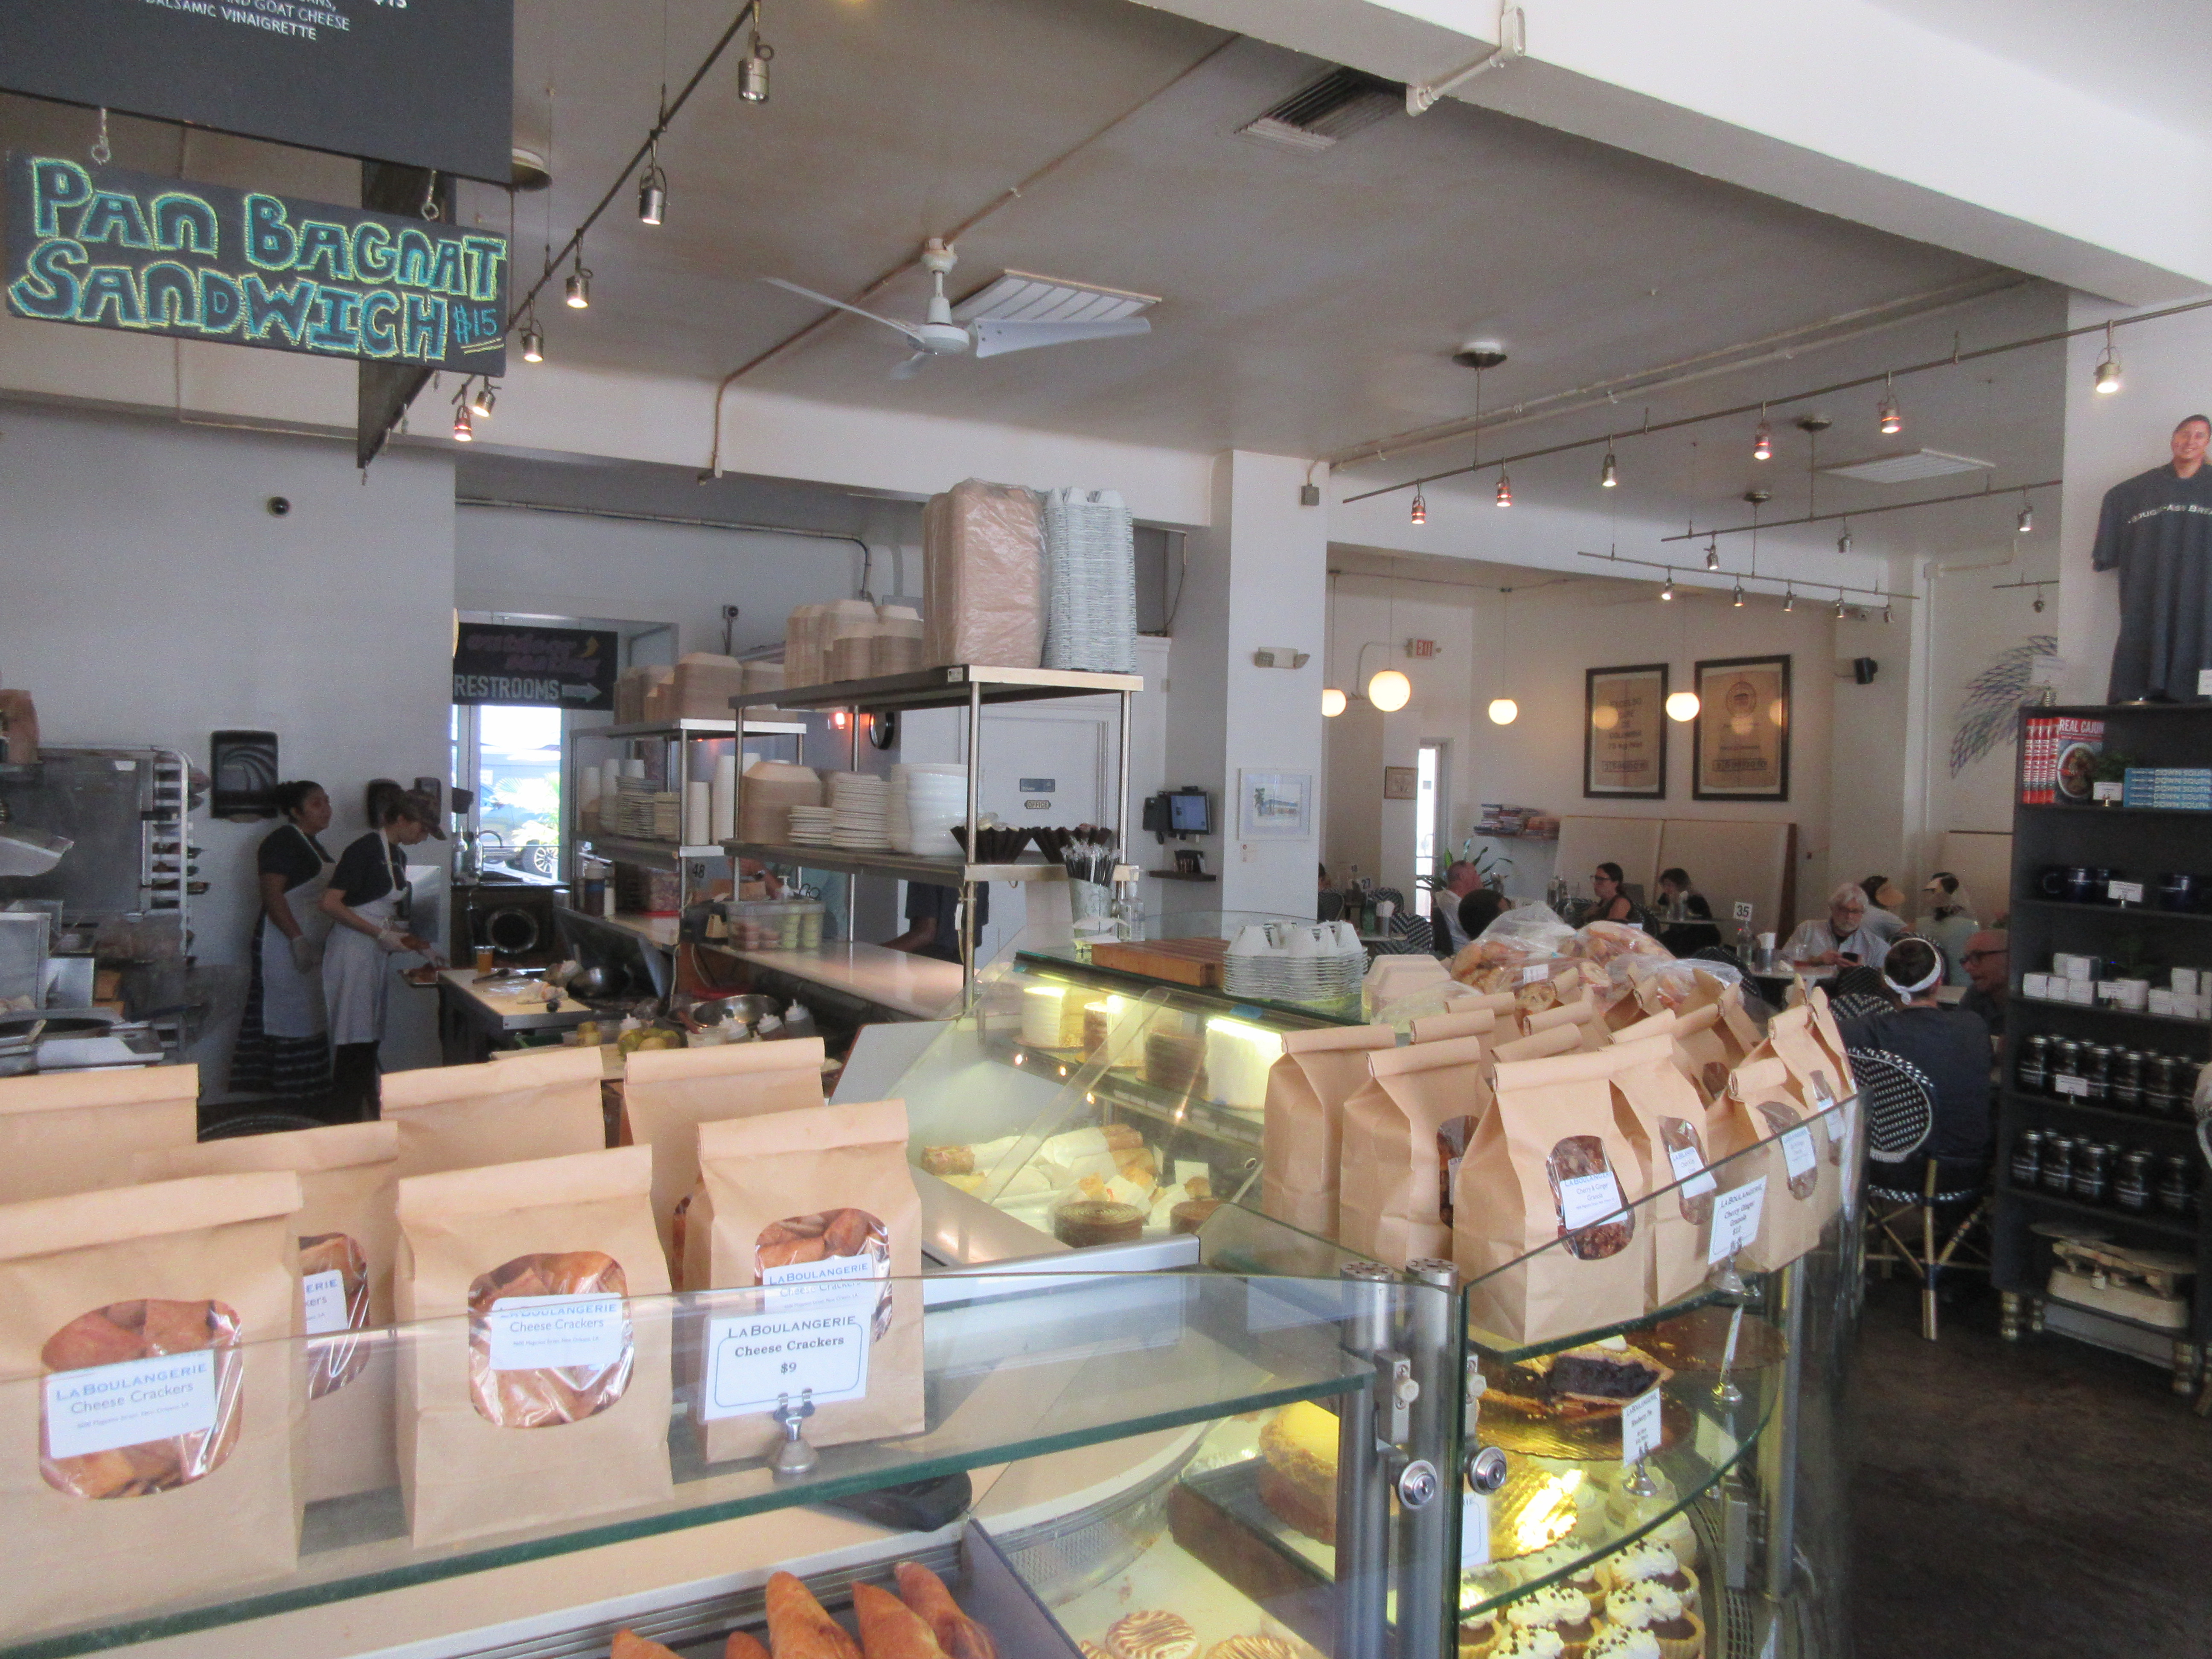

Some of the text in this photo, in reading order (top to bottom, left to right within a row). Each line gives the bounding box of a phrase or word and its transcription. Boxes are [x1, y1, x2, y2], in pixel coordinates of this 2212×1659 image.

[221, 6, 317, 41] VINAIGRETTE
[255, 0, 296, 17] GOAT
[299, 7, 350, 32] CHEESE
[453, 303, 498, 344] $15
[1416, 640, 1433, 657] EXIT
[453, 674, 559, 701] RESTROOMS
[2059, 719, 2104, 733] REAL CAJUN
[692, 863, 705, 879] 48
[1361, 878, 1371, 889] 27
[1737, 905, 1749, 917] 35
[780, 1286, 816, 1297] Cheese
[510, 1318, 604, 1332] Cheese Crackers
[735, 1336, 844, 1357] Cheese Crackers
[780, 1362, 797, 1375] $9
[71, 1382, 194, 1414] Cheese Crackers
